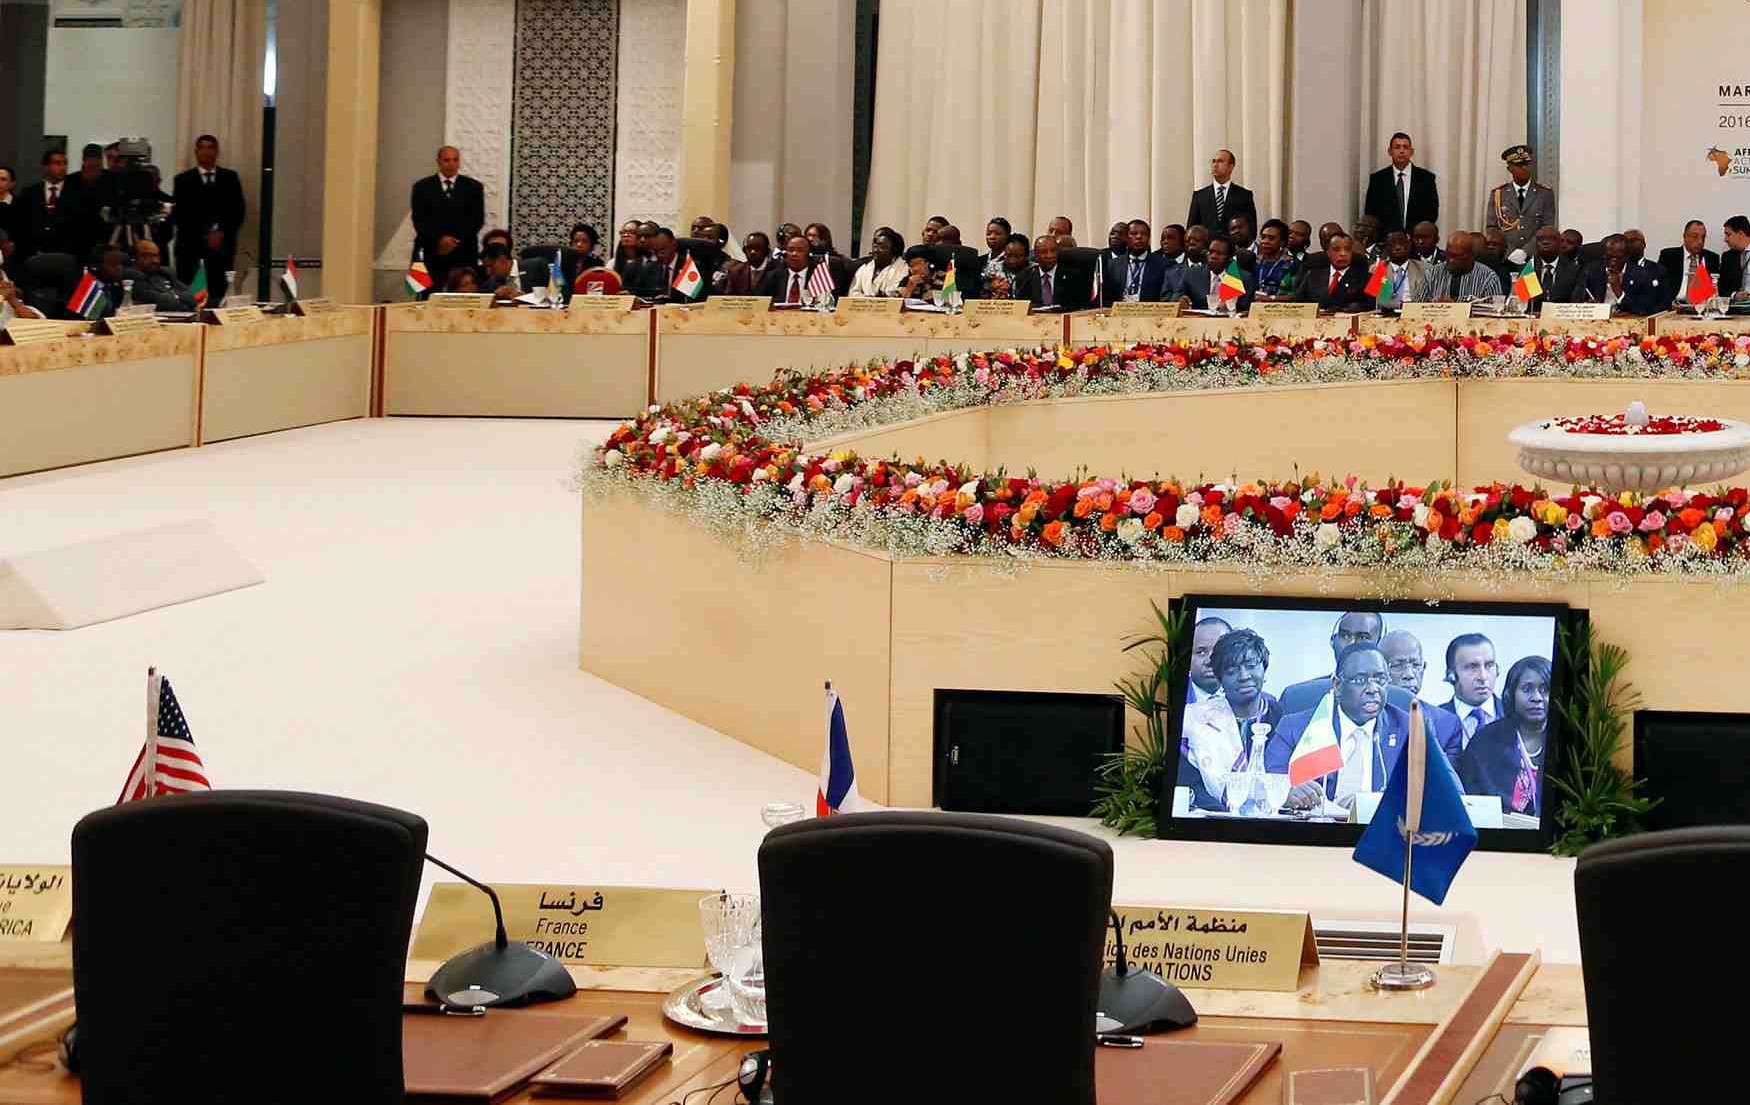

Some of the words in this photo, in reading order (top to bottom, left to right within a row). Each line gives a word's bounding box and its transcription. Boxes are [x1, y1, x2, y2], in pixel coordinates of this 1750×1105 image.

[539, 891, 604, 916] فرنسا
[536, 918, 588, 935] France
[1129, 911, 1180, 935] الأمم
[1185, 915, 1248, 934] منظمة
[1132, 943, 1158, 959] des
[1163, 943, 1221, 961] Nations
[1226, 945, 1268, 963] Unies
